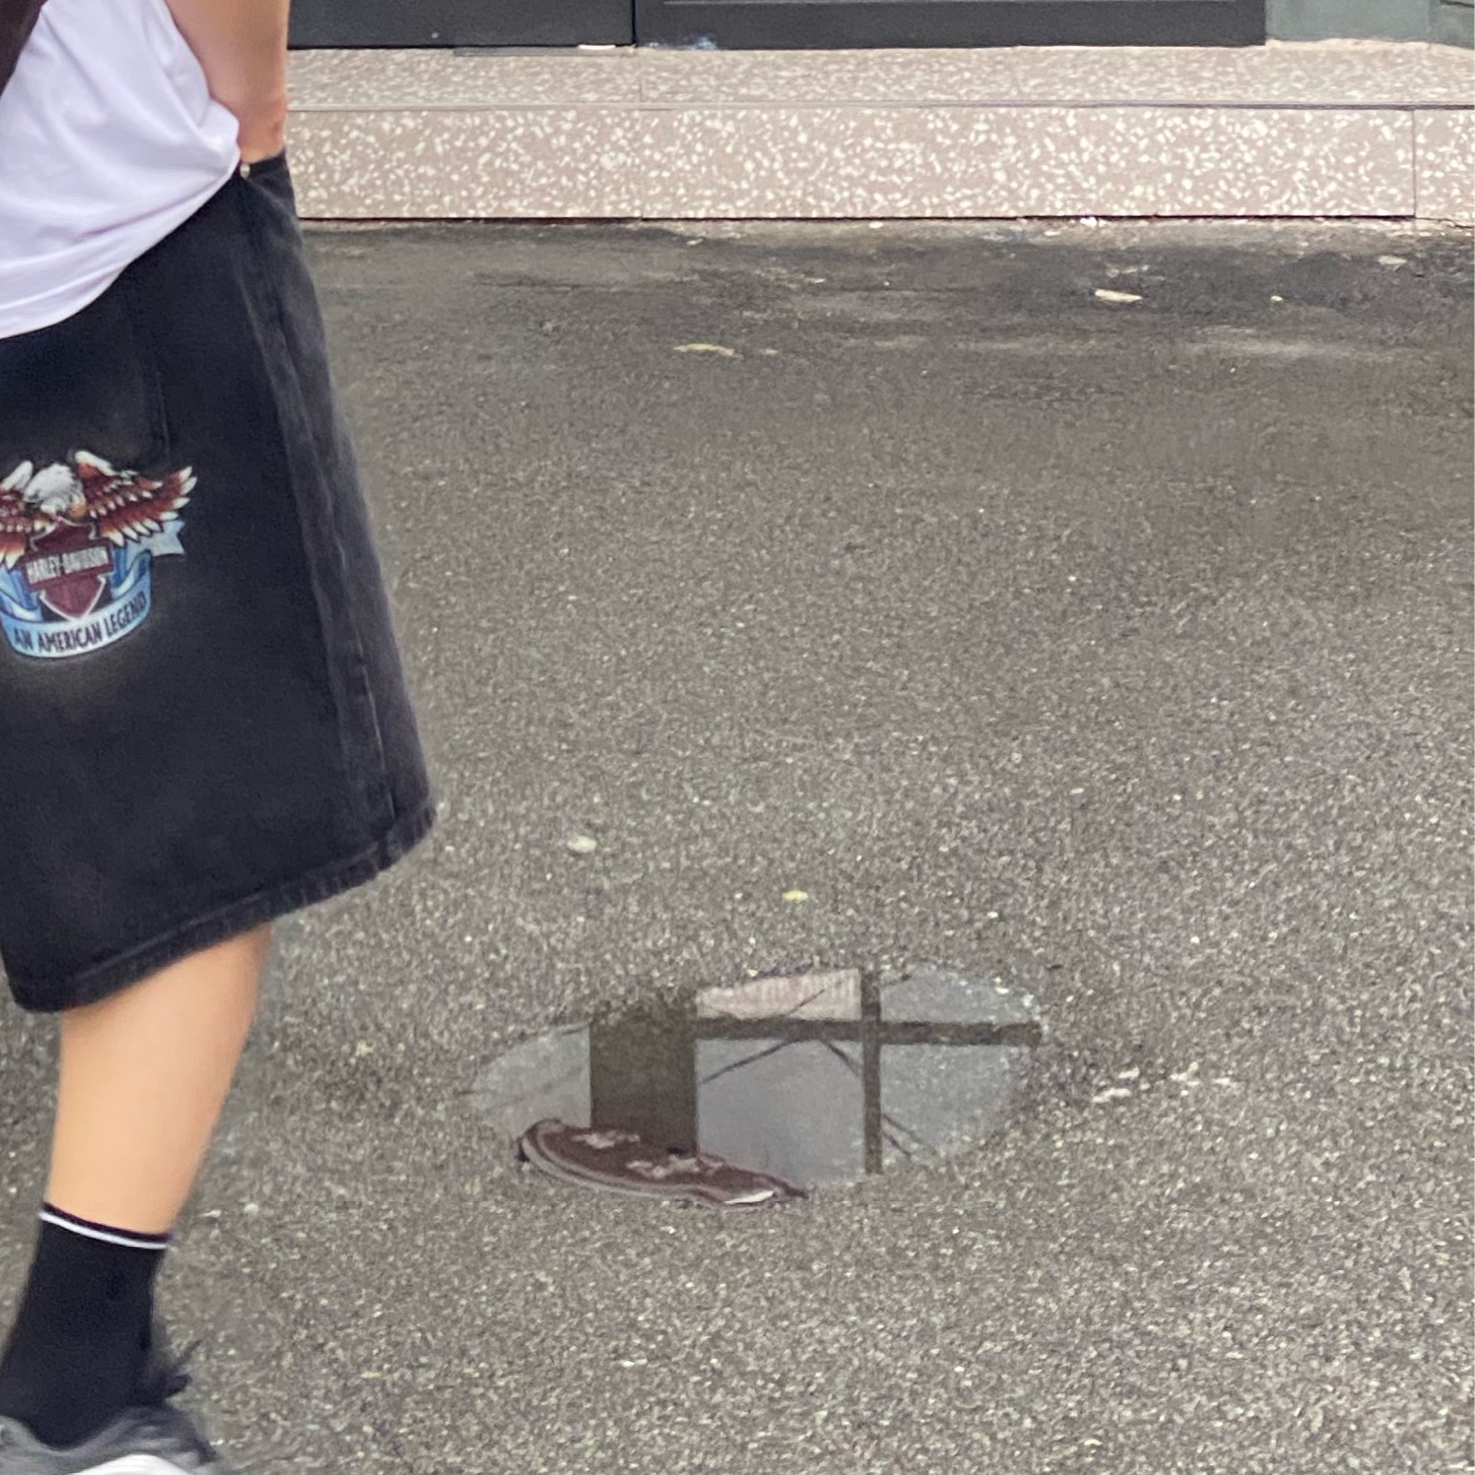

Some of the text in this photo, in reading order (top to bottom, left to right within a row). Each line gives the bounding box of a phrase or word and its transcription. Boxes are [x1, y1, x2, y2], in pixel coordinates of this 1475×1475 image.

[14, 592, 147, 653] AN AMERICAN LEGEND
